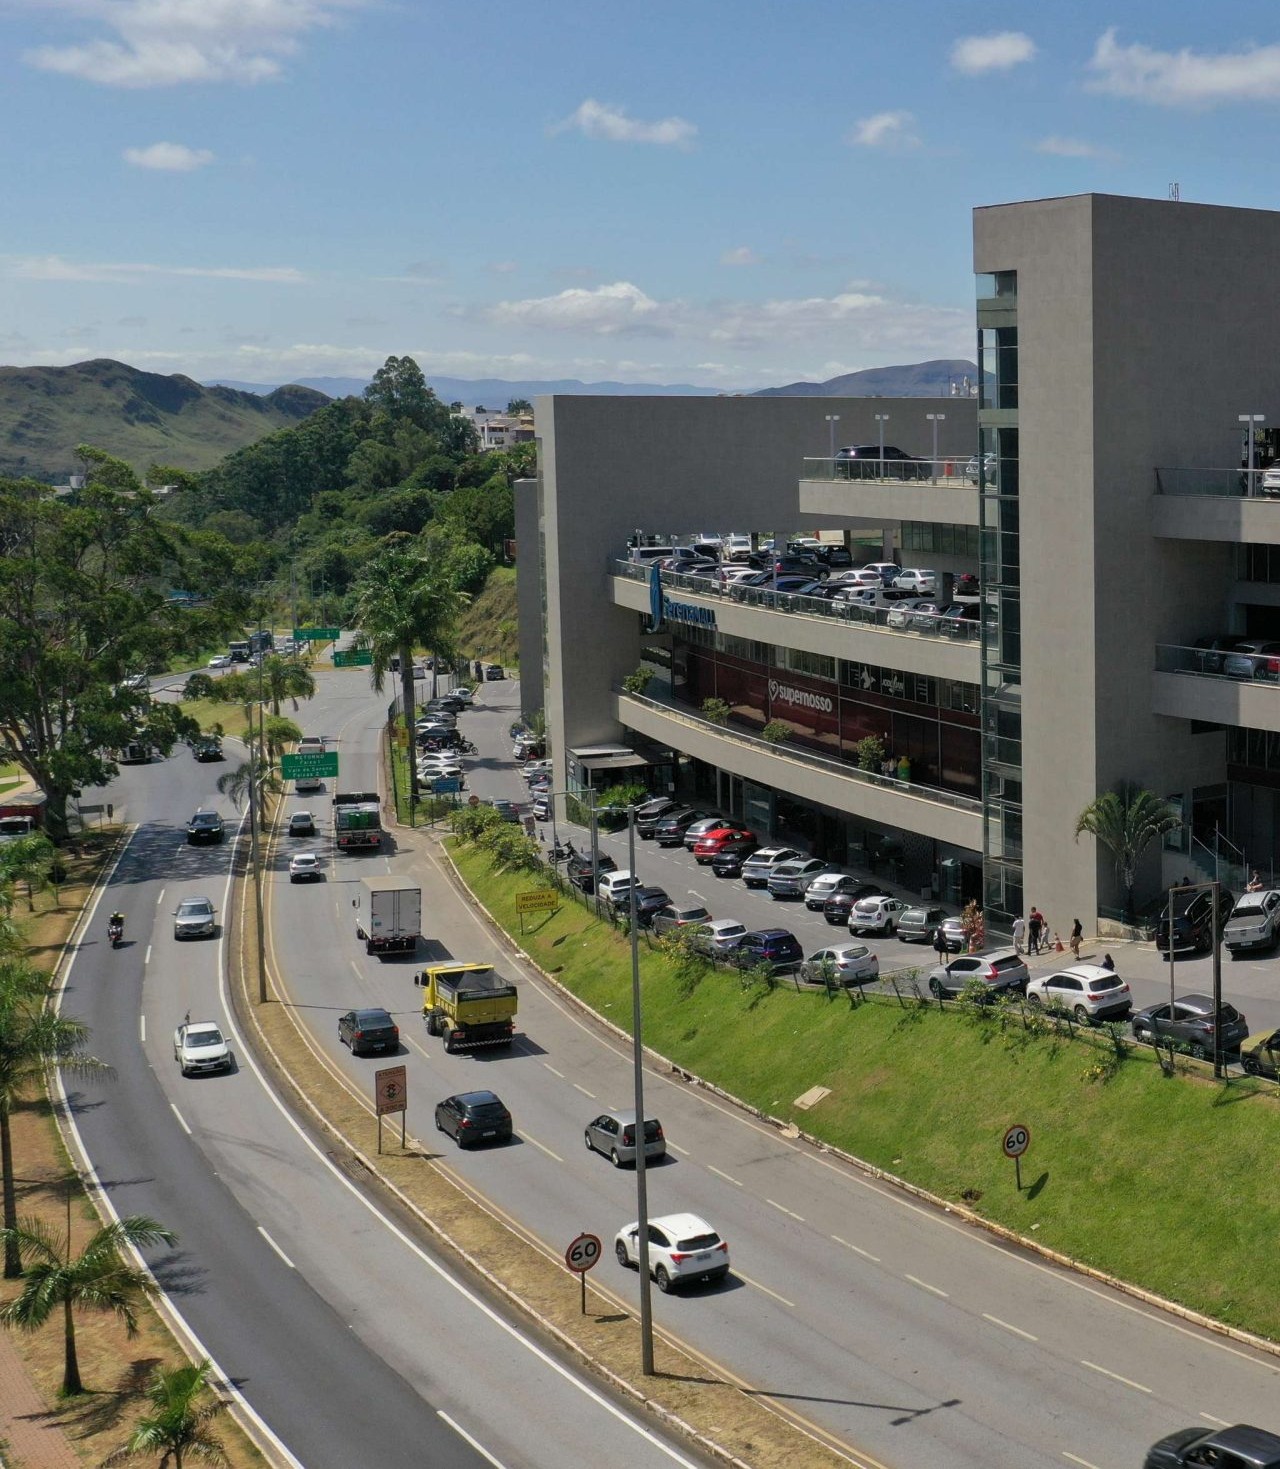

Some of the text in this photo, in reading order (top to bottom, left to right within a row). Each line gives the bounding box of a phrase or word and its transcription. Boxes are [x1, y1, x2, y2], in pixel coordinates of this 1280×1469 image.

[779, 685, 833, 712] supernosso
[518, 900, 556, 910] VELOCIDADE
[521, 894, 545, 902] REDUZA
[1006, 1131, 1026, 1149] 60
[571, 1241, 597, 1262] 60
